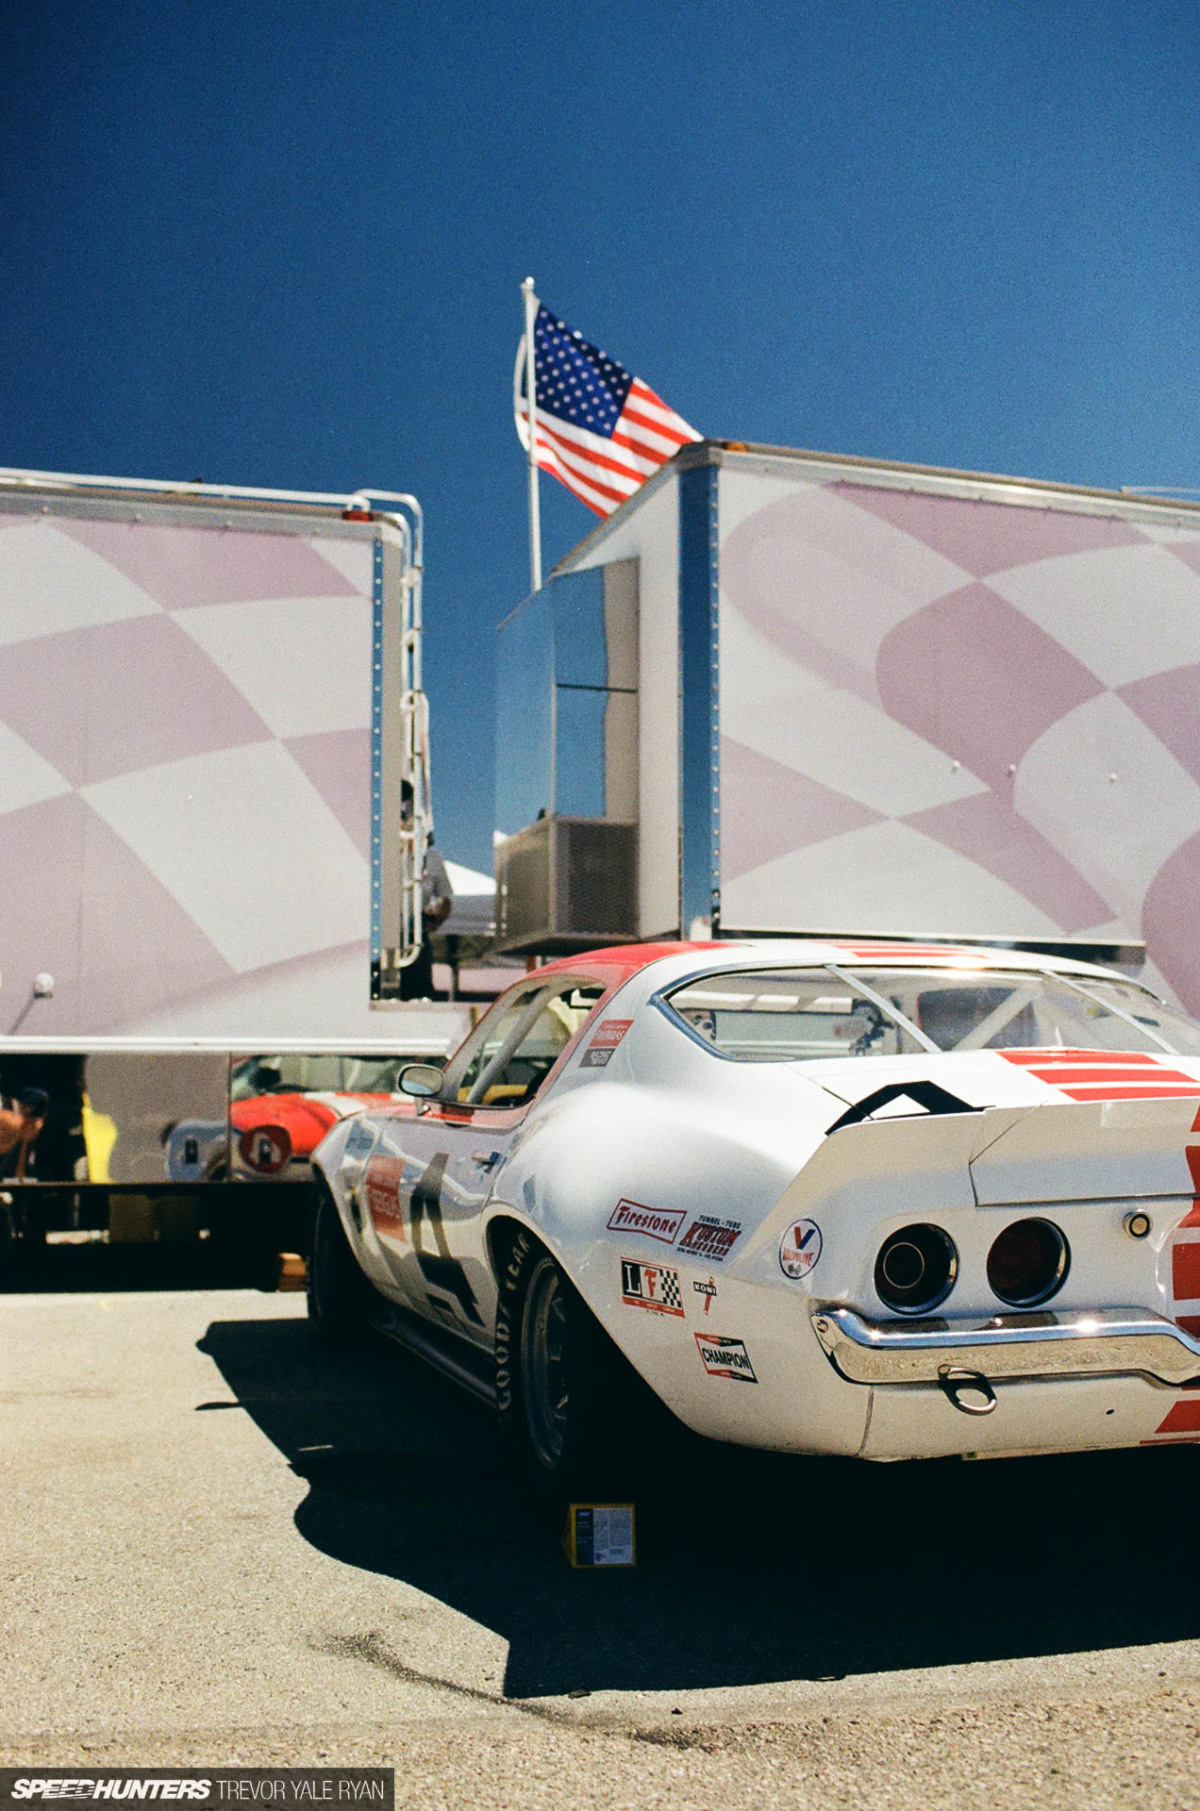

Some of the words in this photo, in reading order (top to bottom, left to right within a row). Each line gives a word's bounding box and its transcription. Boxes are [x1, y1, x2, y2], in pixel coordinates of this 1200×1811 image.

[614, 1205, 677, 1234] Firestone
[679, 1221, 742, 1248] KUSTOM
[694, 1283, 716, 1295] KONI
[701, 1347, 750, 1370] CHAMPION
